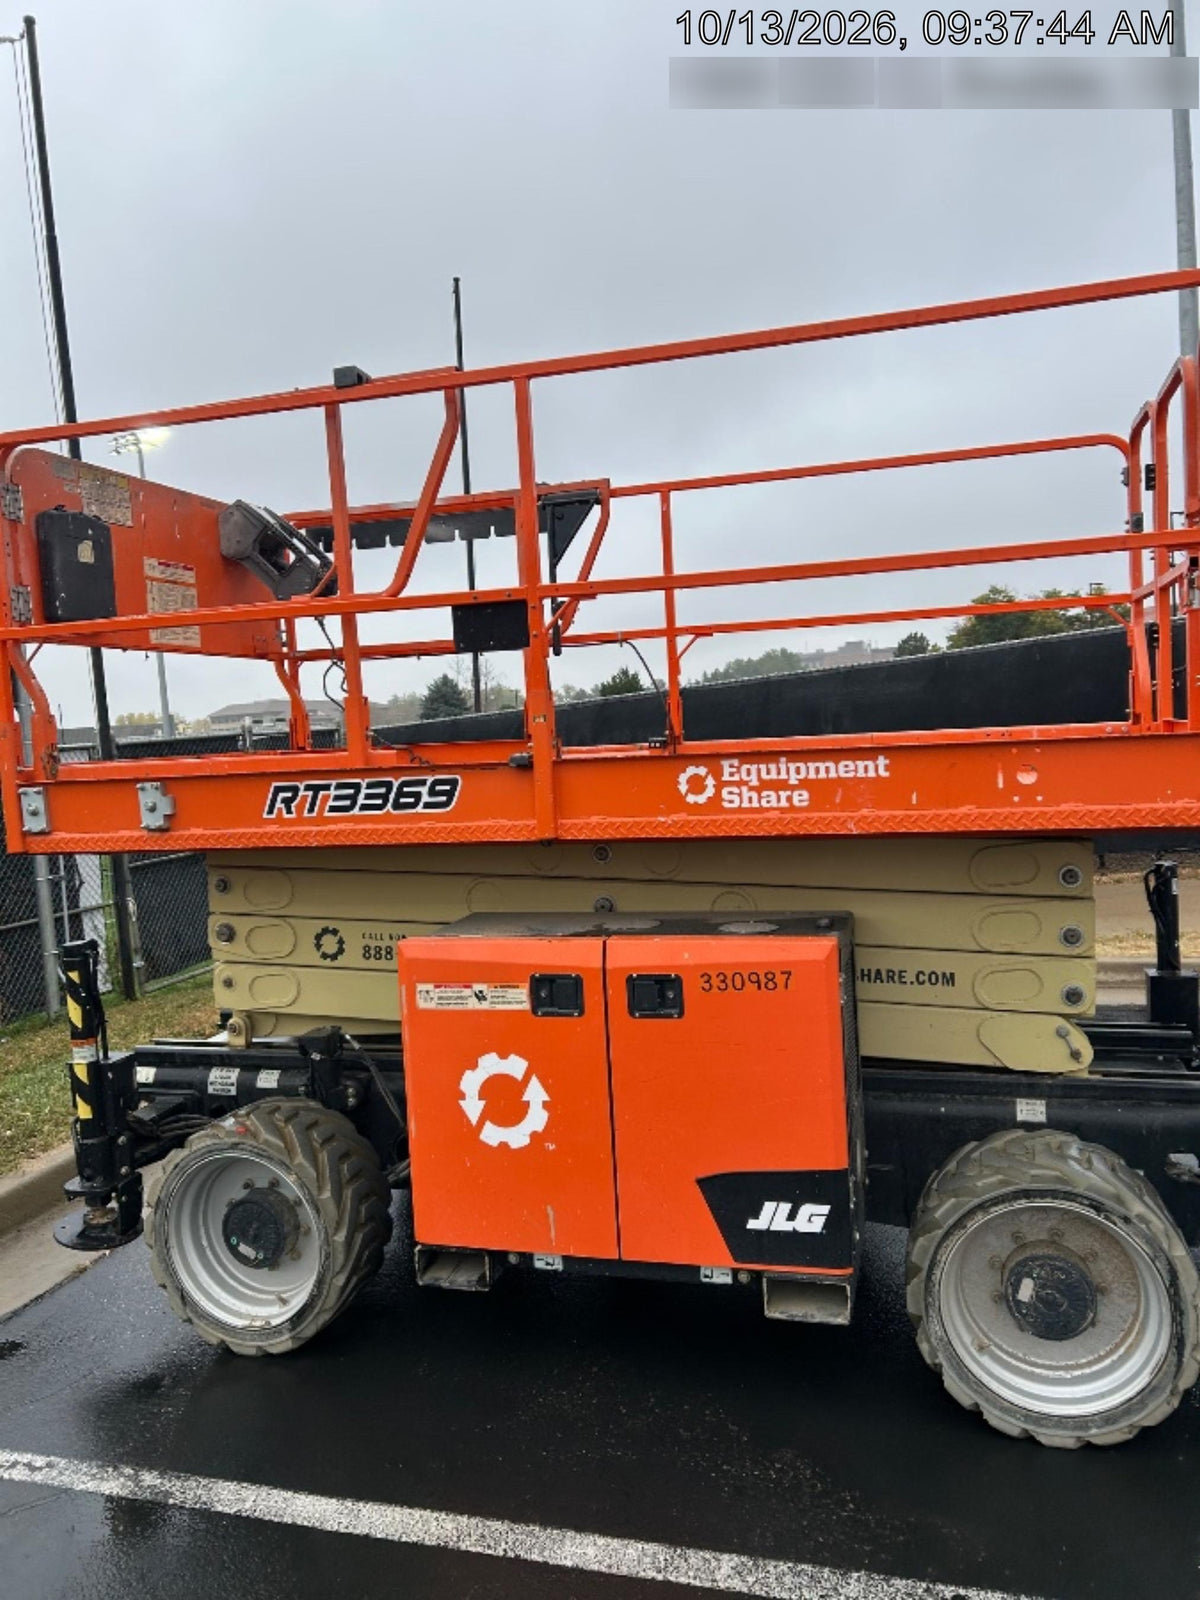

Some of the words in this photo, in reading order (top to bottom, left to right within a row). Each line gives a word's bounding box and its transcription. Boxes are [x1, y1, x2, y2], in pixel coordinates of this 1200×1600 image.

[720, 755, 890, 787] Equipment
[262, 775, 462, 818] RT3369
[721, 786, 810, 809] Share
[699, 969, 793, 993] 330987
[856, 968, 956, 987] HARE.COM
[746, 1201, 832, 1233] JLG
